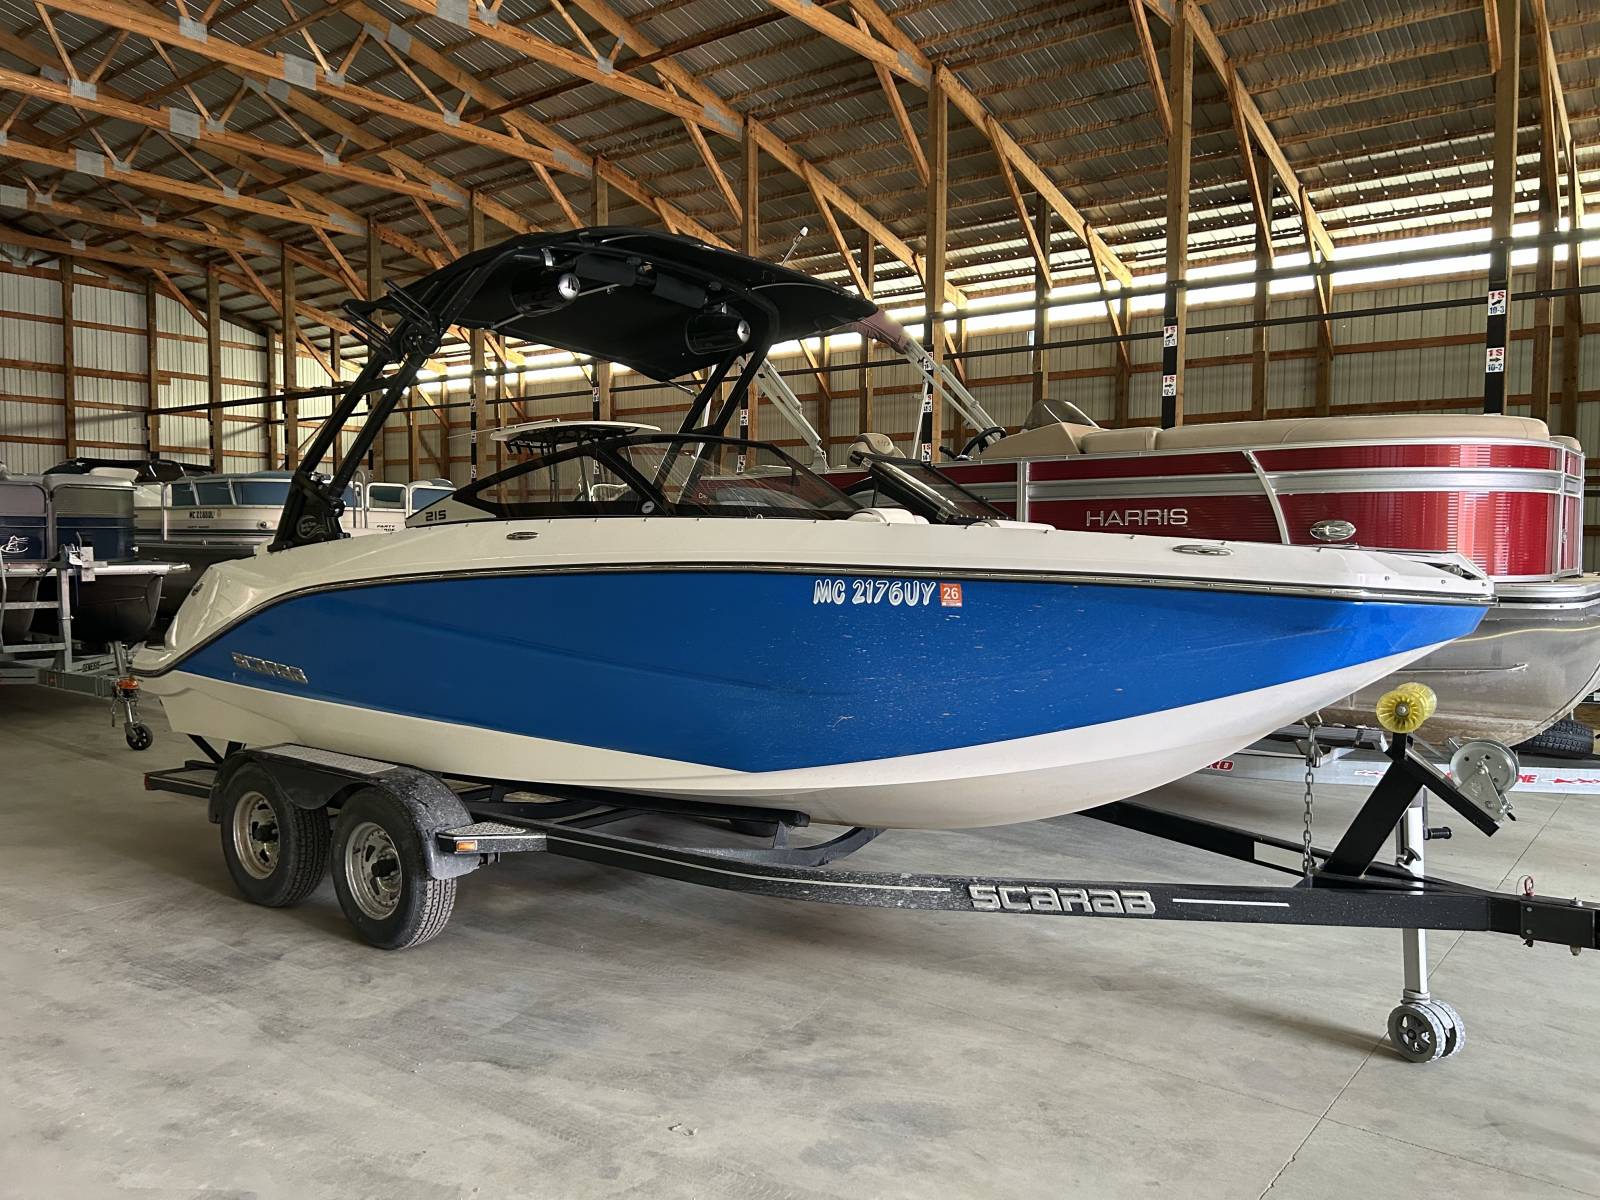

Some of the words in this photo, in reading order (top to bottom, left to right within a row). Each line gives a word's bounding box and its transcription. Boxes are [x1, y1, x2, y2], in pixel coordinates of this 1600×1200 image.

[425, 509, 447, 522] 215
[1086, 508, 1189, 527] HARRIS
[812, 578, 846, 606] MC
[851, 579, 937, 607] 2176UY
[943, 587, 959, 600] 26
